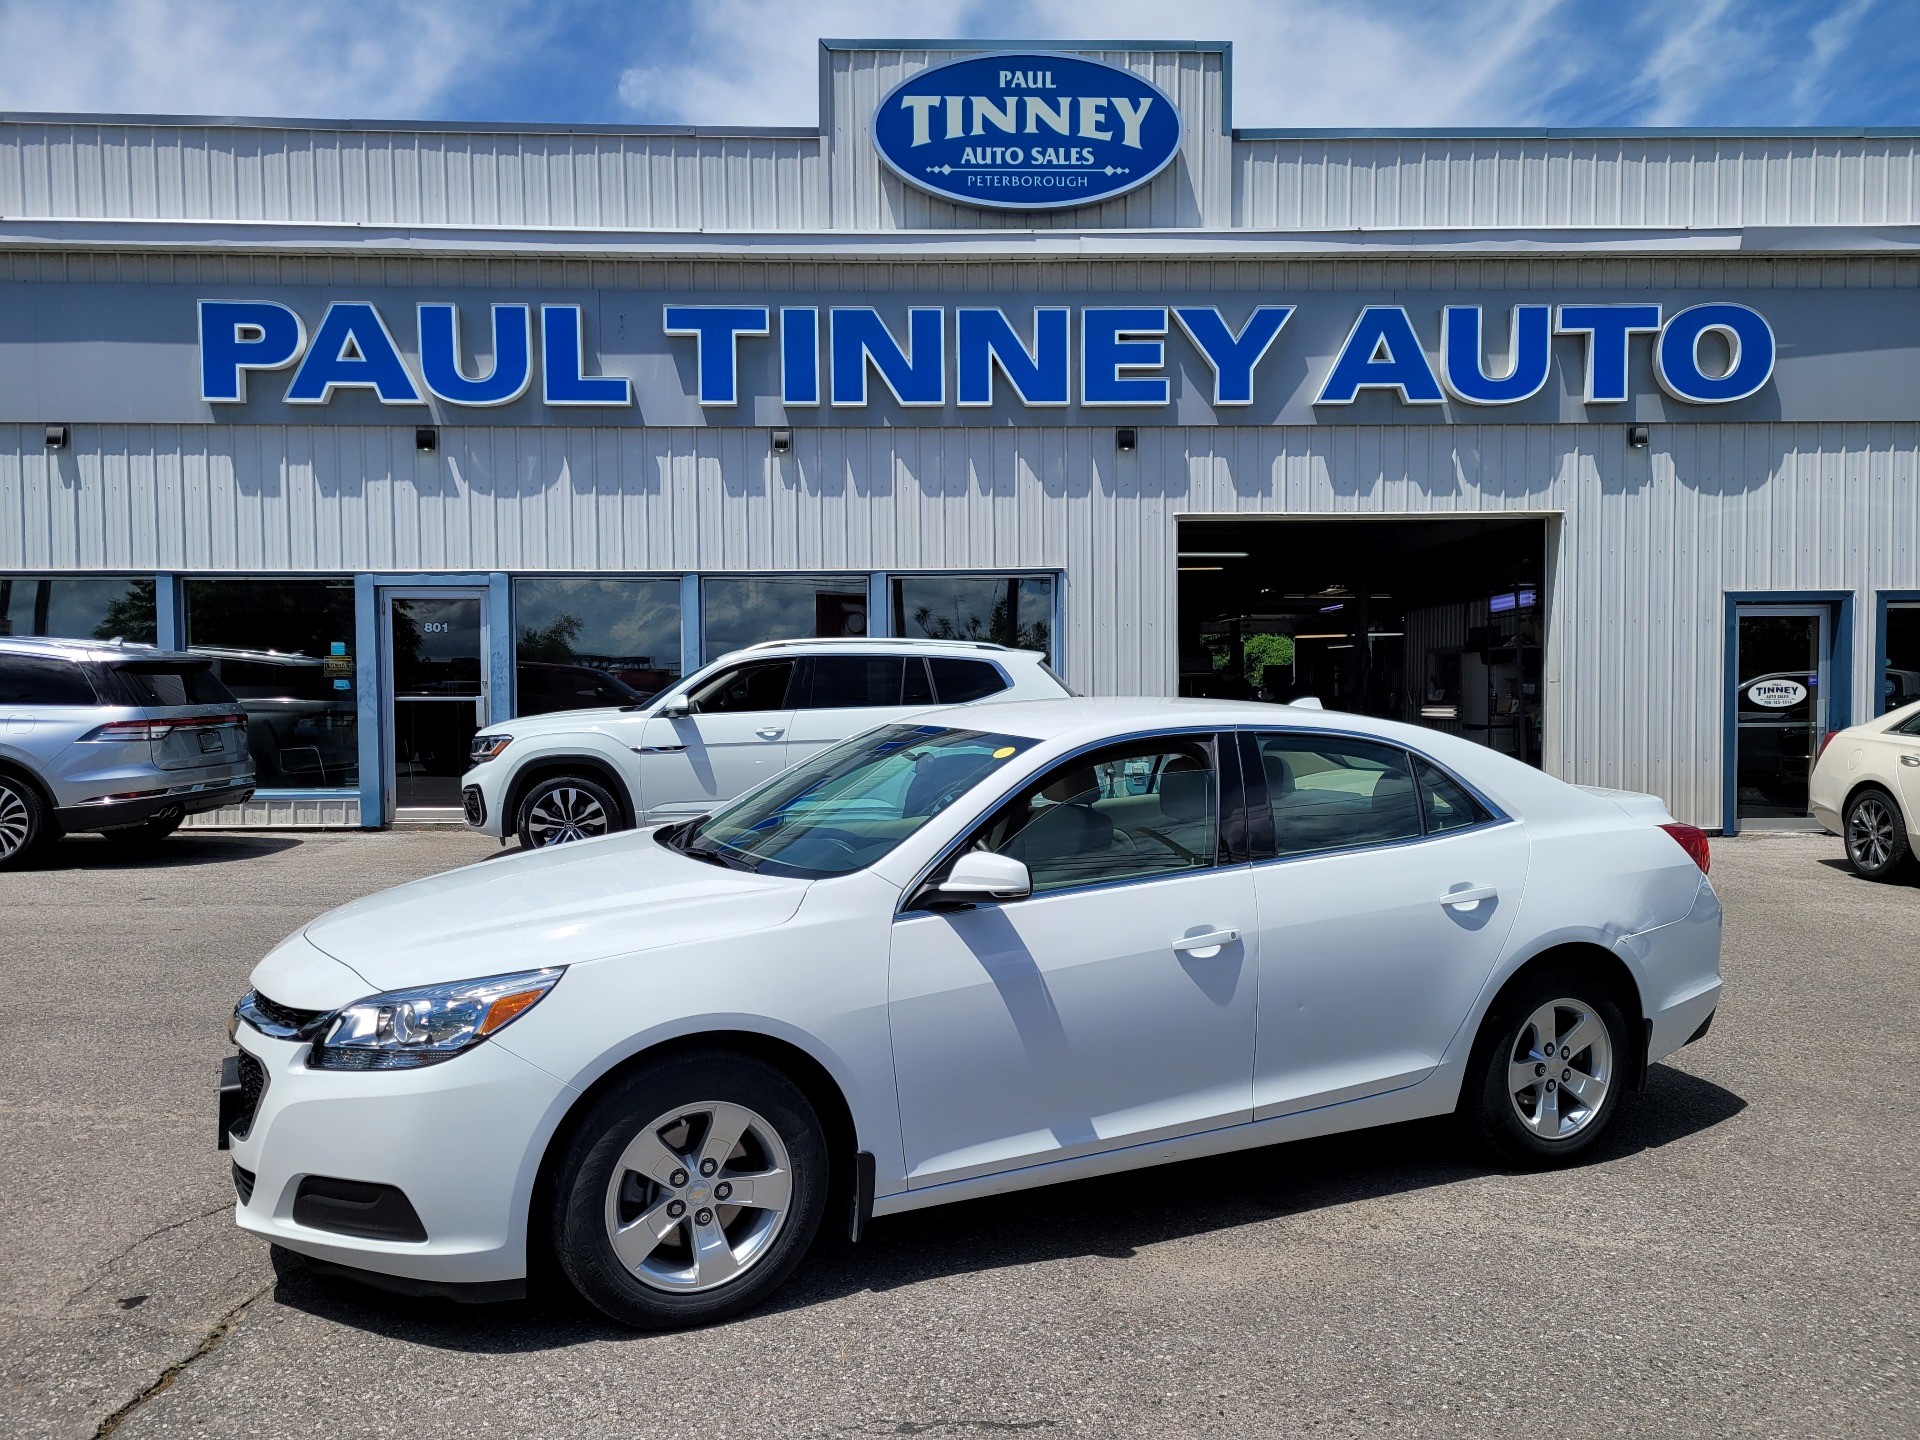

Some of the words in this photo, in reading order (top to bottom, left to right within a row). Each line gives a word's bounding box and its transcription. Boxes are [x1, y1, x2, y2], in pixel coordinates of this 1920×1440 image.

[999, 71, 1056, 88] PAUL
[901, 96, 1153, 150] TINNEY
[961, 147, 1023, 165] AUTO
[1031, 147, 1094, 165] SALES
[968, 175, 1088, 187] PETERBOROUGH
[197, 299, 632, 407] PAUL
[663, 304, 1297, 407] TINNEY
[1313, 302, 1776, 406] AUTO
[424, 622, 448, 633] 801
[1756, 686, 1798, 696] TINNEY
